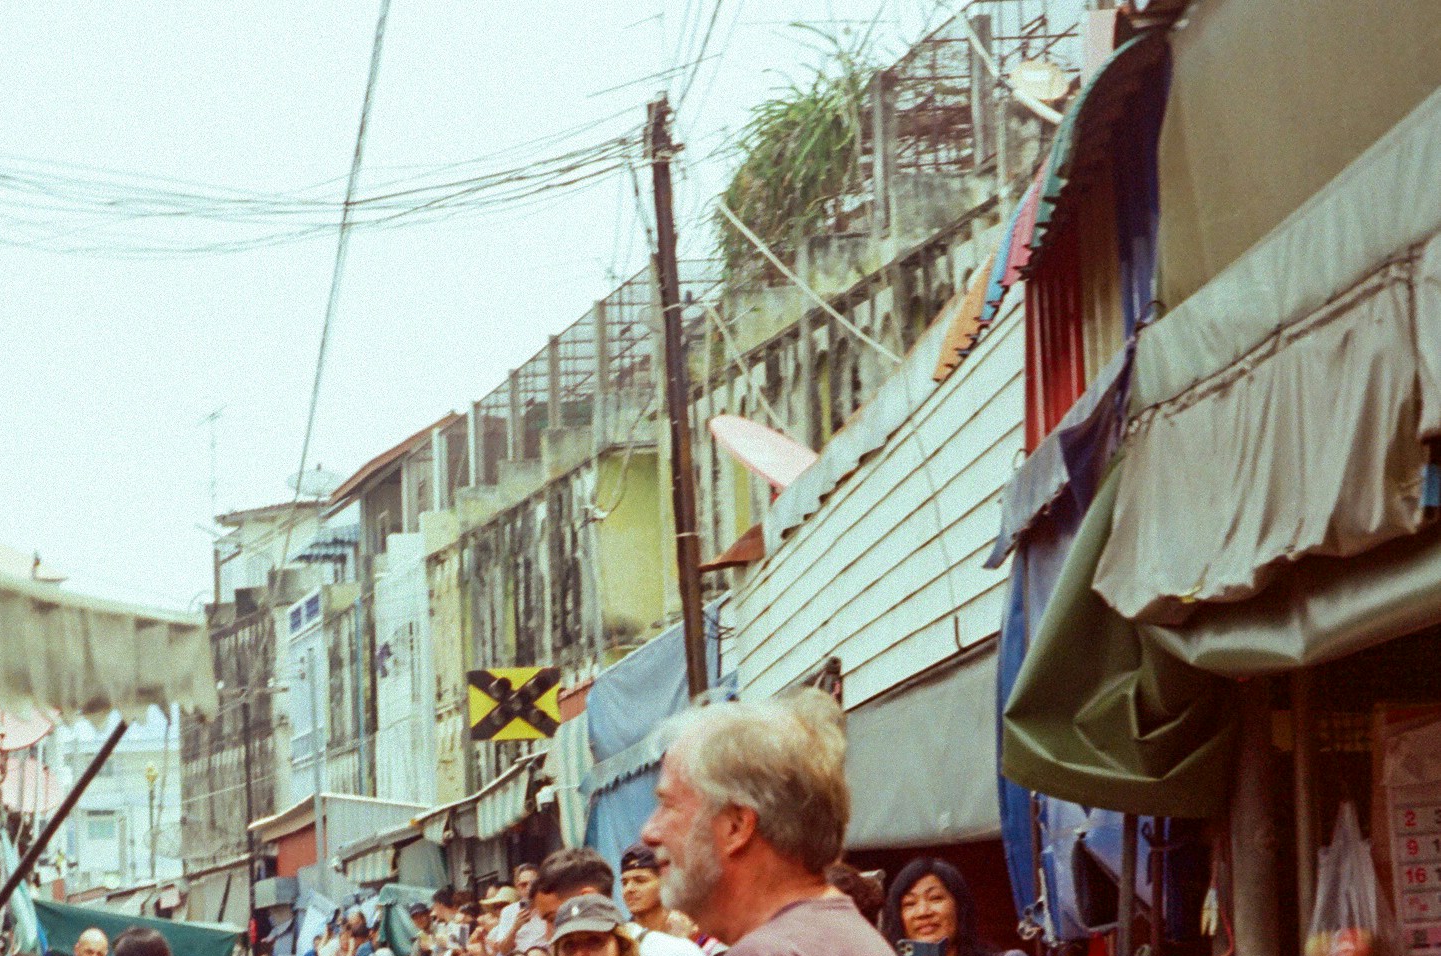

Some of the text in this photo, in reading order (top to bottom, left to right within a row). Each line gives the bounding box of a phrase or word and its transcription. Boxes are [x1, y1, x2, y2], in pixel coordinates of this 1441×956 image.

[1404, 809, 1417, 827] 2
[1406, 838, 1419, 856] 9
[1405, 867, 1427, 884] 16
